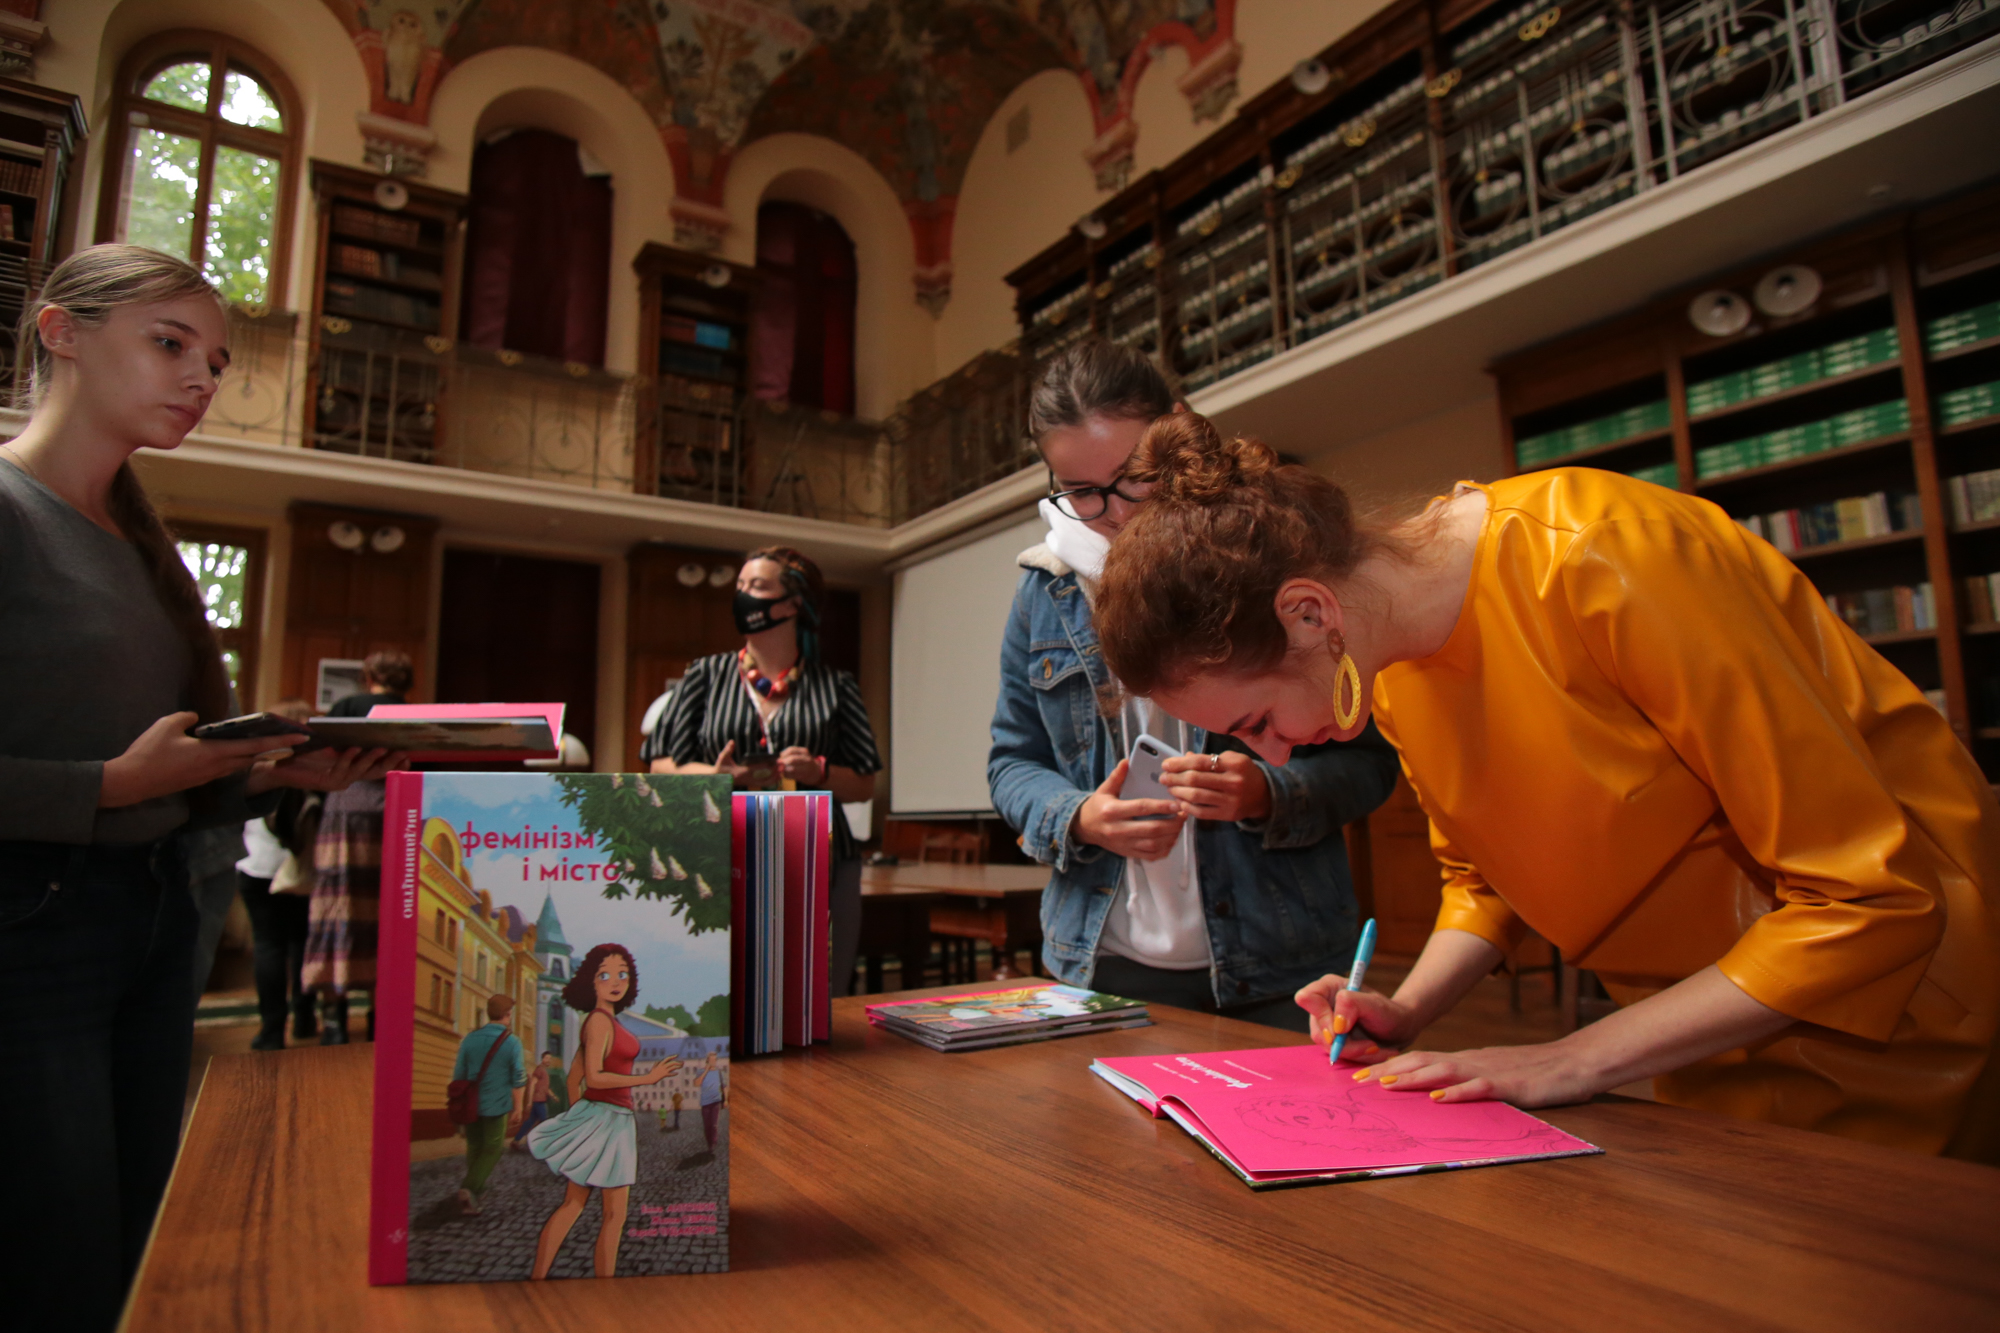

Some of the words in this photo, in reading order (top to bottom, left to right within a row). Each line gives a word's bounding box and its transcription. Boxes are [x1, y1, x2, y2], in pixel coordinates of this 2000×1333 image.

[459, 820, 595, 857] фемінізм
[402, 809, 417, 918] видавництво
[522, 857, 530, 881] і
[539, 857, 620, 881] місто
